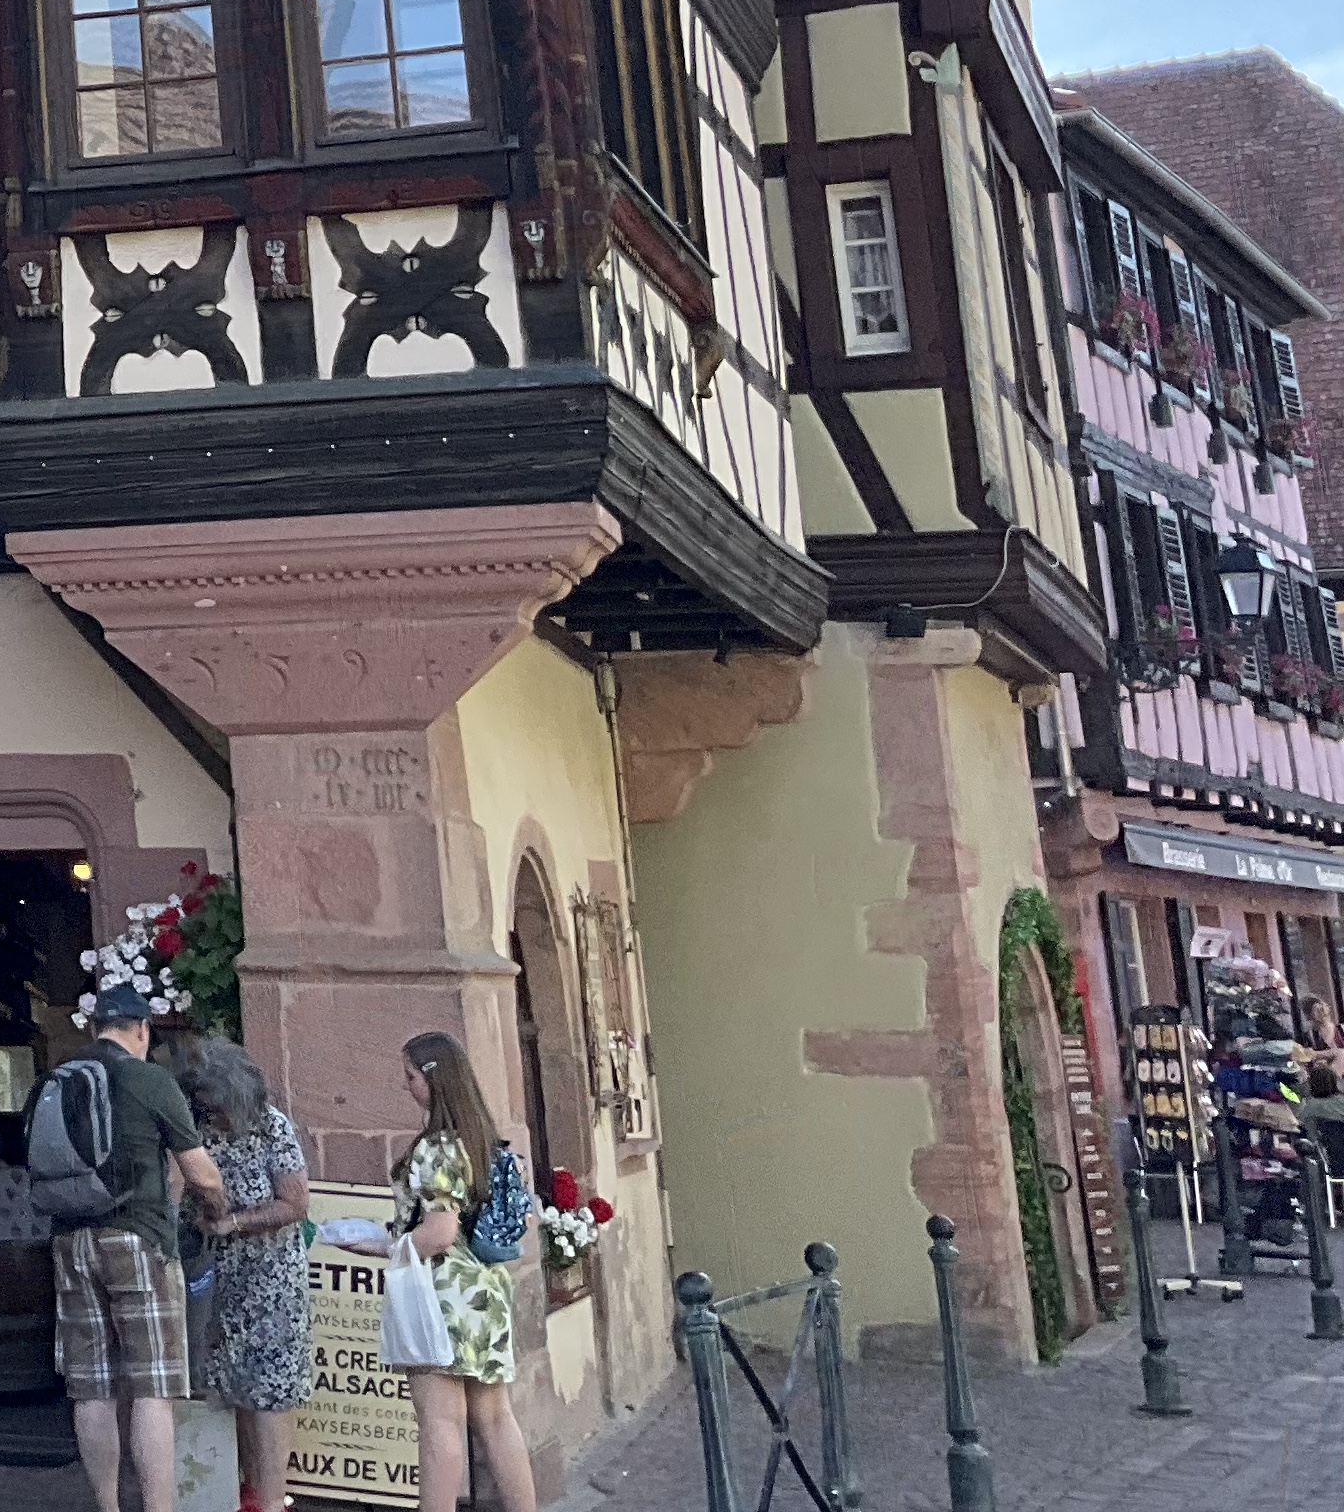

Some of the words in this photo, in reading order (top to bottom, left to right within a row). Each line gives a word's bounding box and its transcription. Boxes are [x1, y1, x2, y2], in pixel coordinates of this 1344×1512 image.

[309, 1313, 381, 1331] AYSERSB
[315, 1347, 328, 1367] &
[343, 1403, 369, 1417] des
[296, 1417, 420, 1443] KAYSERSBERG
[343, 1458, 377, 1481] DE
